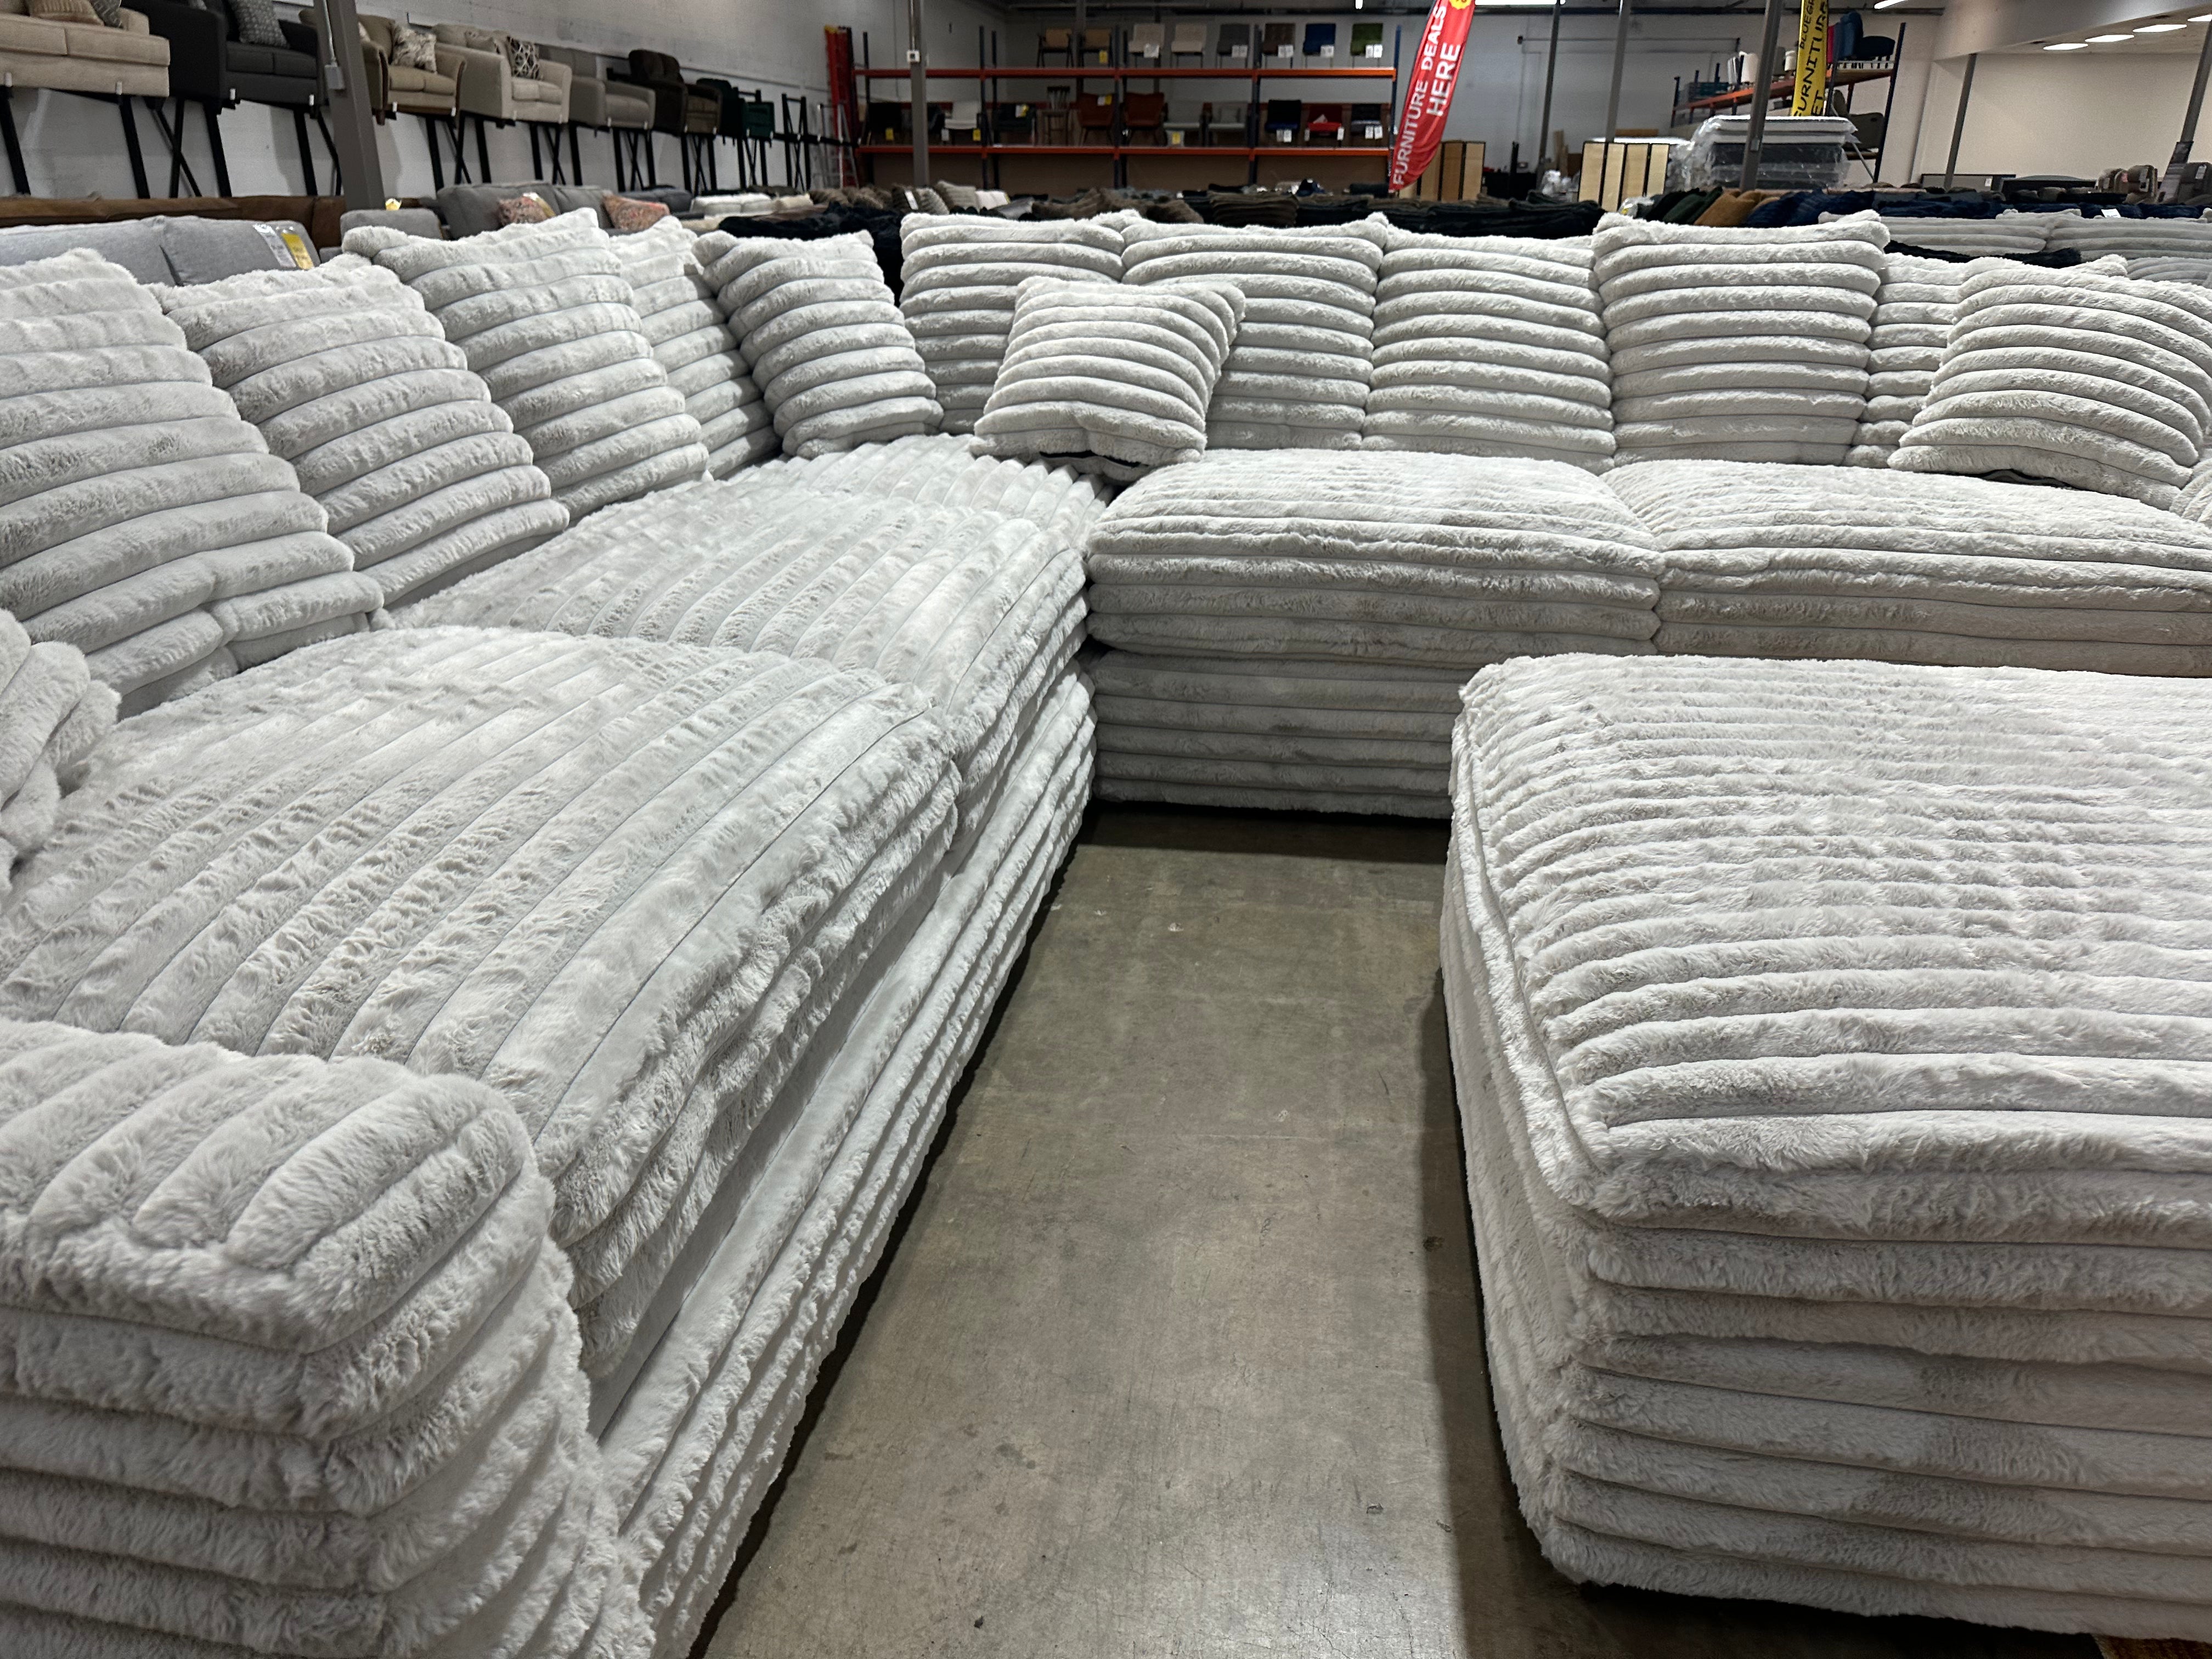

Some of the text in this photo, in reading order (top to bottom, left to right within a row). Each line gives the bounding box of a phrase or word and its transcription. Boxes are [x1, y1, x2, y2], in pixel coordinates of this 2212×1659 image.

[1393, 6, 1447, 185] FURNITURE DEALS
[1426, 42, 1461, 117] HERE
